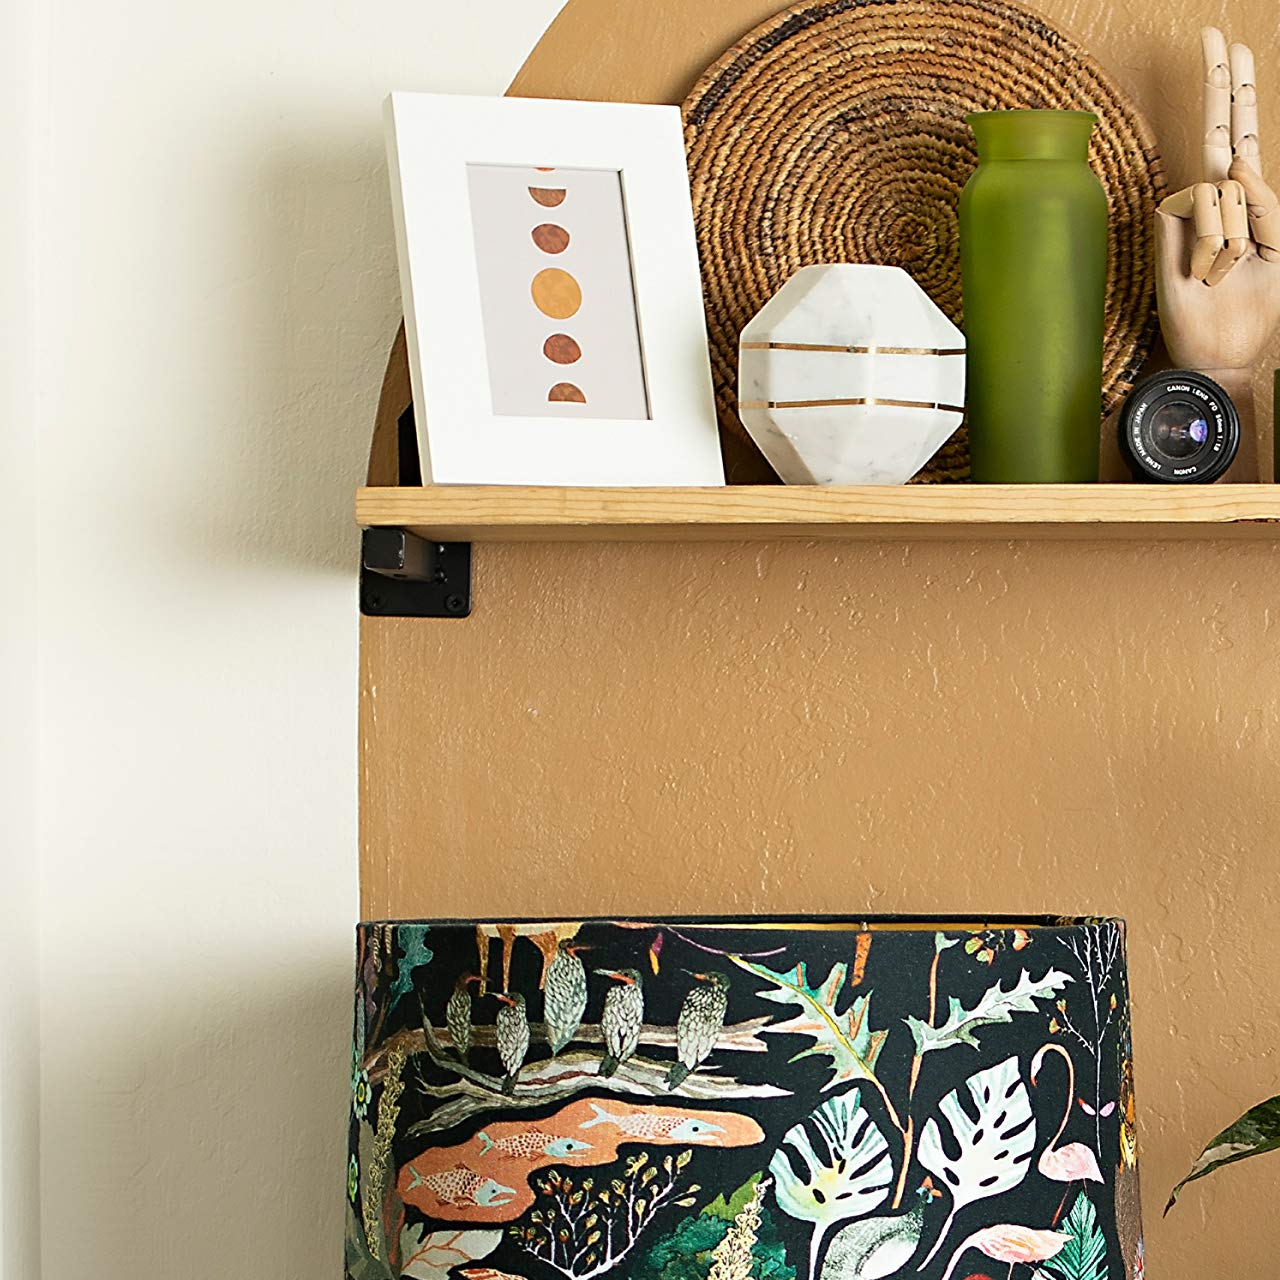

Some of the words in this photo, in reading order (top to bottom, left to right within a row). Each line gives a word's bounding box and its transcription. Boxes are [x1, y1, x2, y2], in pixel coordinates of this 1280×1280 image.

[1167, 385, 1190, 393] CANON
[1192, 388, 1208, 400] LENS
[1134, 402, 1148, 424] JAPAN
[1134, 437, 1146, 457] MADE
[1146, 457, 1161, 470] LENS
[1173, 466, 1197, 475] CANON
